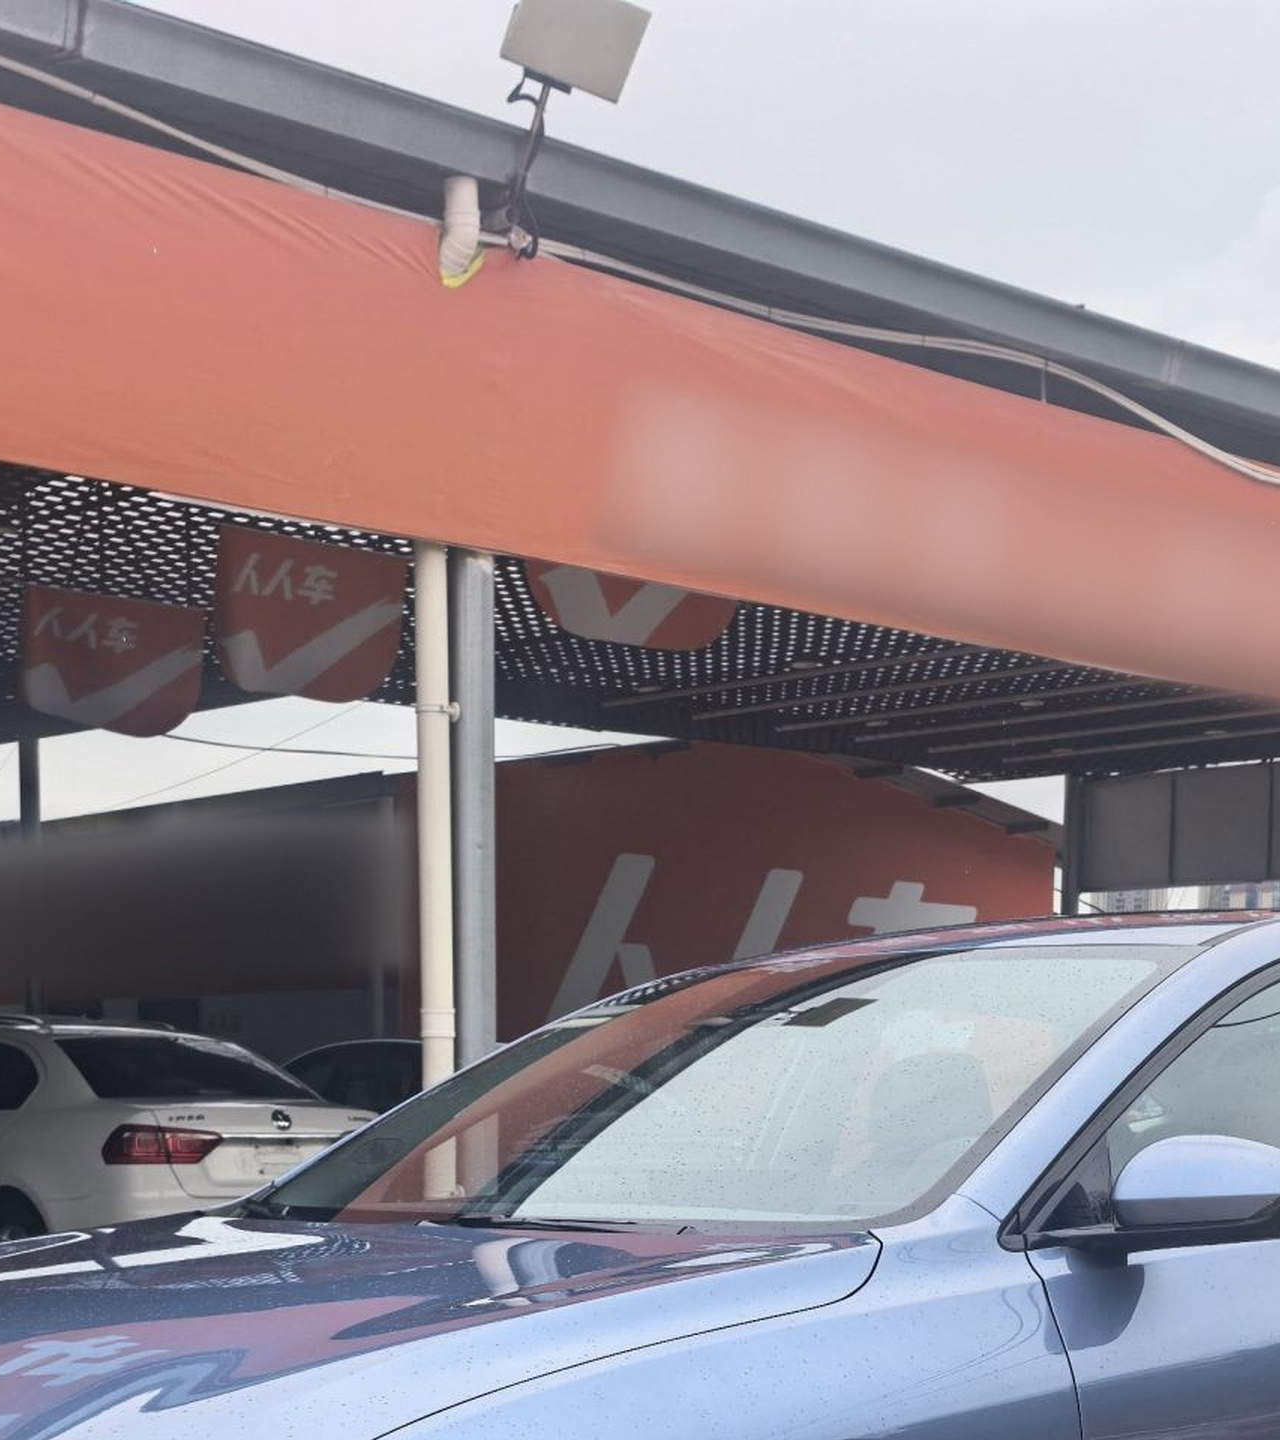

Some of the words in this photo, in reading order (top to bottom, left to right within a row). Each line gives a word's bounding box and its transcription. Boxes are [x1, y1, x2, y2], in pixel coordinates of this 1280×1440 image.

[231, 552, 339, 605] 人人车
[33, 606, 140, 655] 人人车
